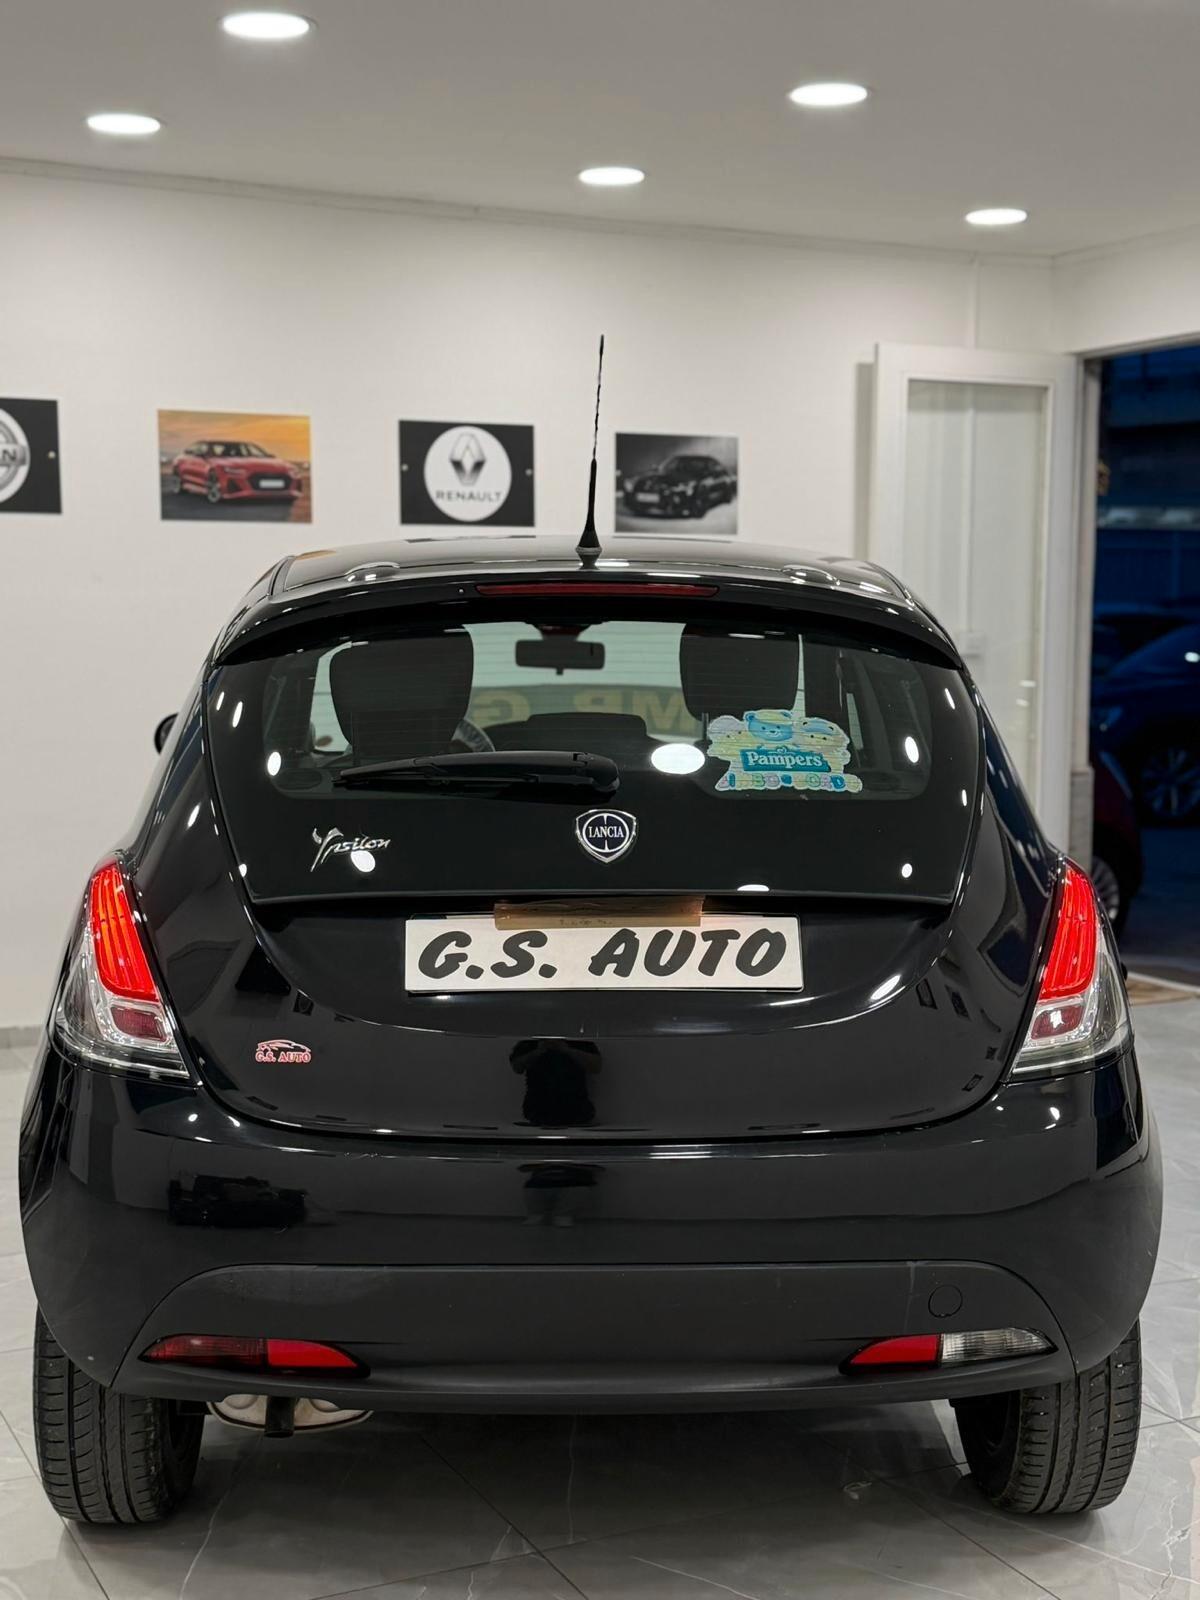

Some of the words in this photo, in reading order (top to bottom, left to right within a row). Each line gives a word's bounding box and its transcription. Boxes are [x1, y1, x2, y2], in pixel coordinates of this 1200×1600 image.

[435, 490, 502, 502] RENAULT
[745, 751, 824, 769] Pampers
[588, 825, 625, 838] LANCIA
[310, 827, 391, 872] Ypsilon
[418, 930, 557, 979] G.S.
[588, 928, 787, 978] AUTO
[255, 1051, 276, 1062] G.S.
[278, 1051, 311, 1062] AUTO
